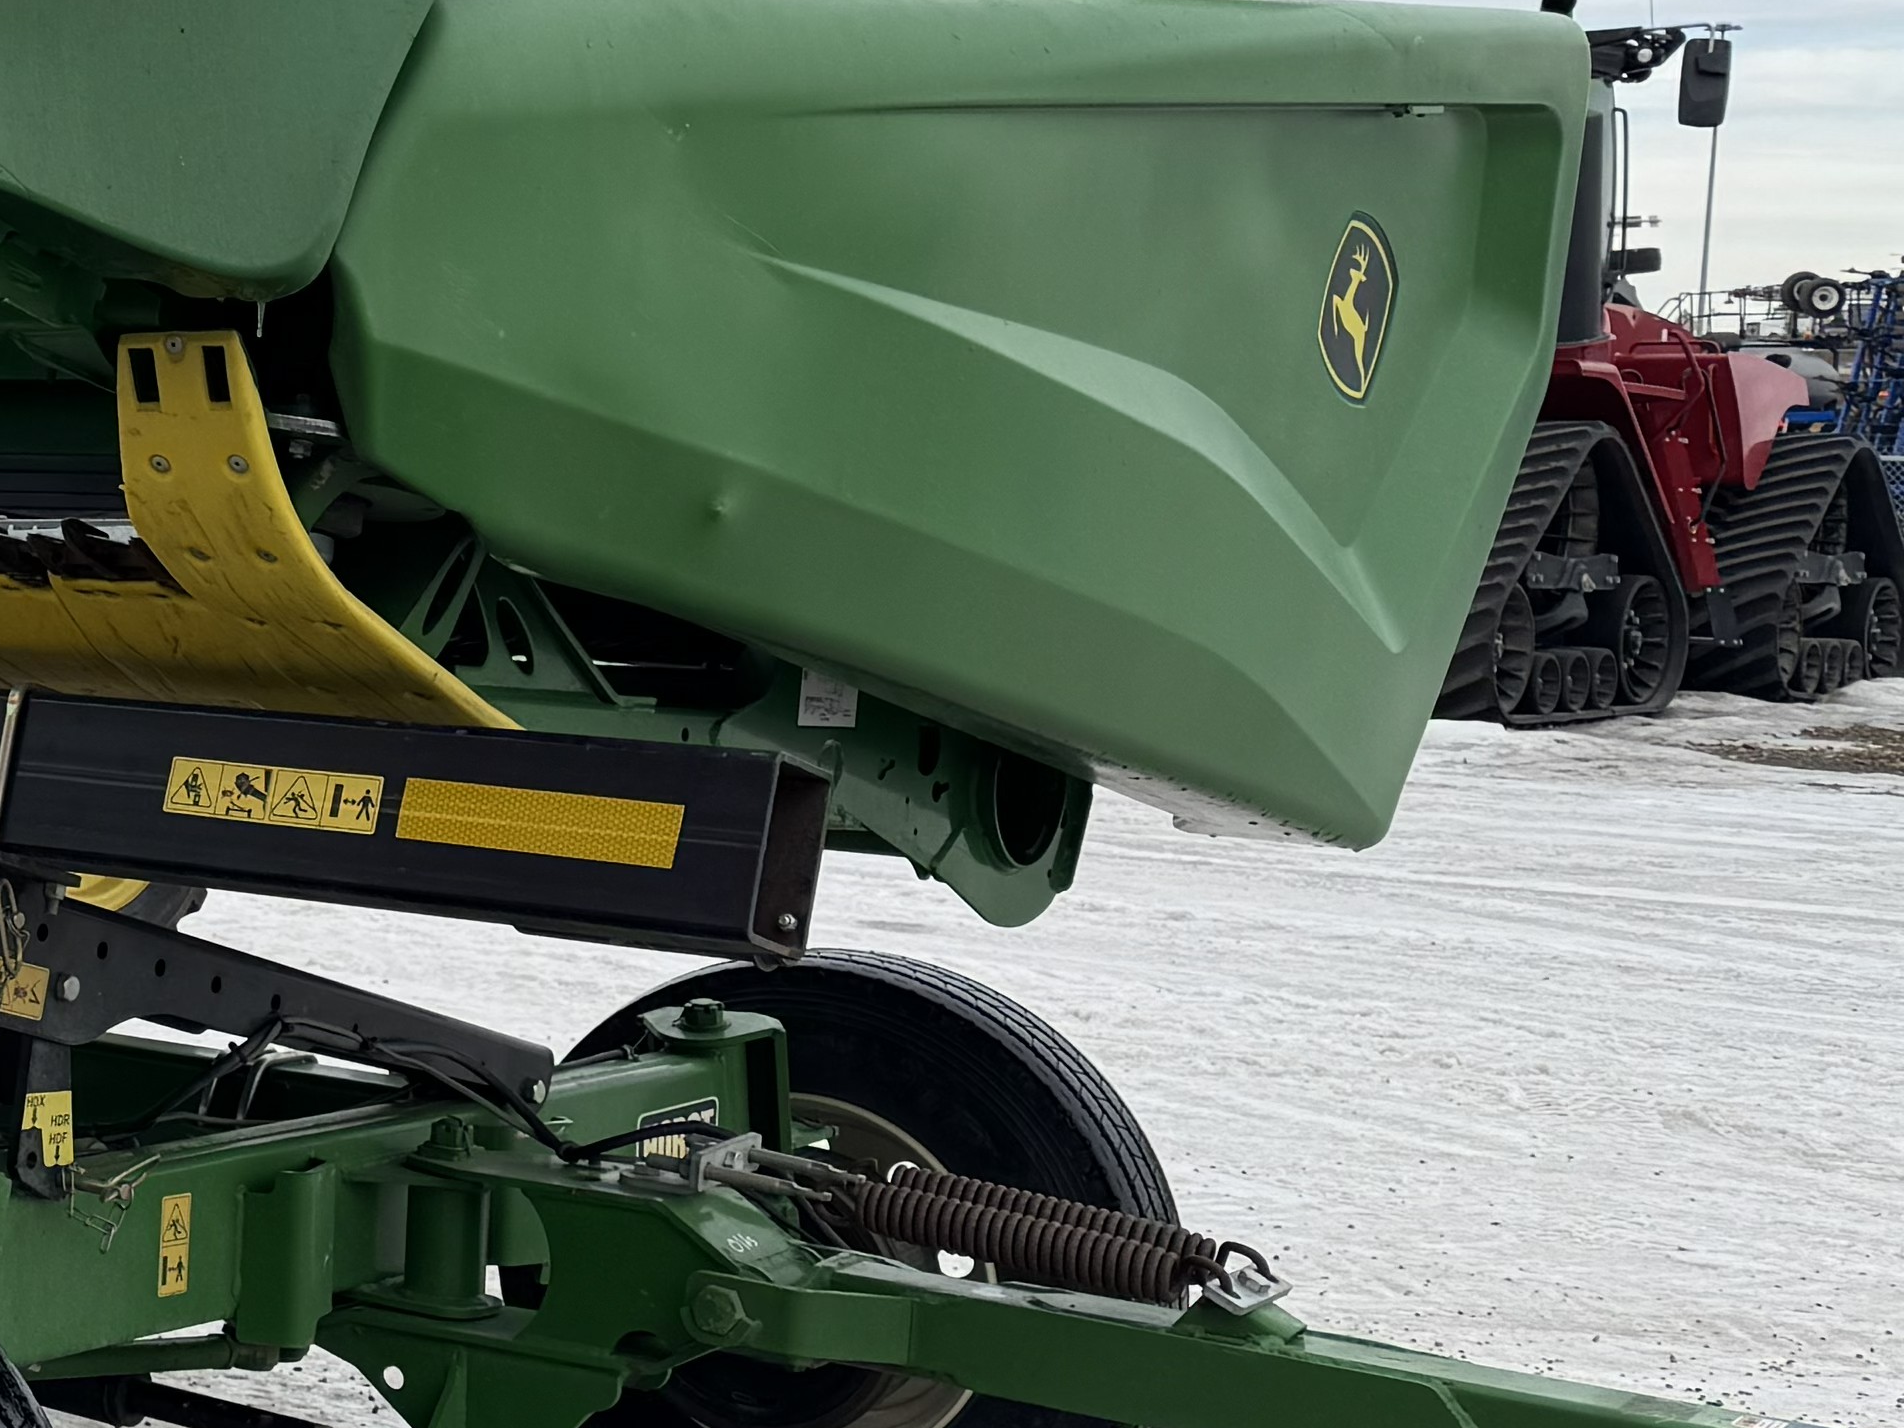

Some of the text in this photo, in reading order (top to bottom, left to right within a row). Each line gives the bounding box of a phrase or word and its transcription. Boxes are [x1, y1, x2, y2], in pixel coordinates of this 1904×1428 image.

[26, 1094, 46, 1107] HDX
[50, 1113, 70, 1127] HDR
[48, 1131, 68, 1145] HDF
